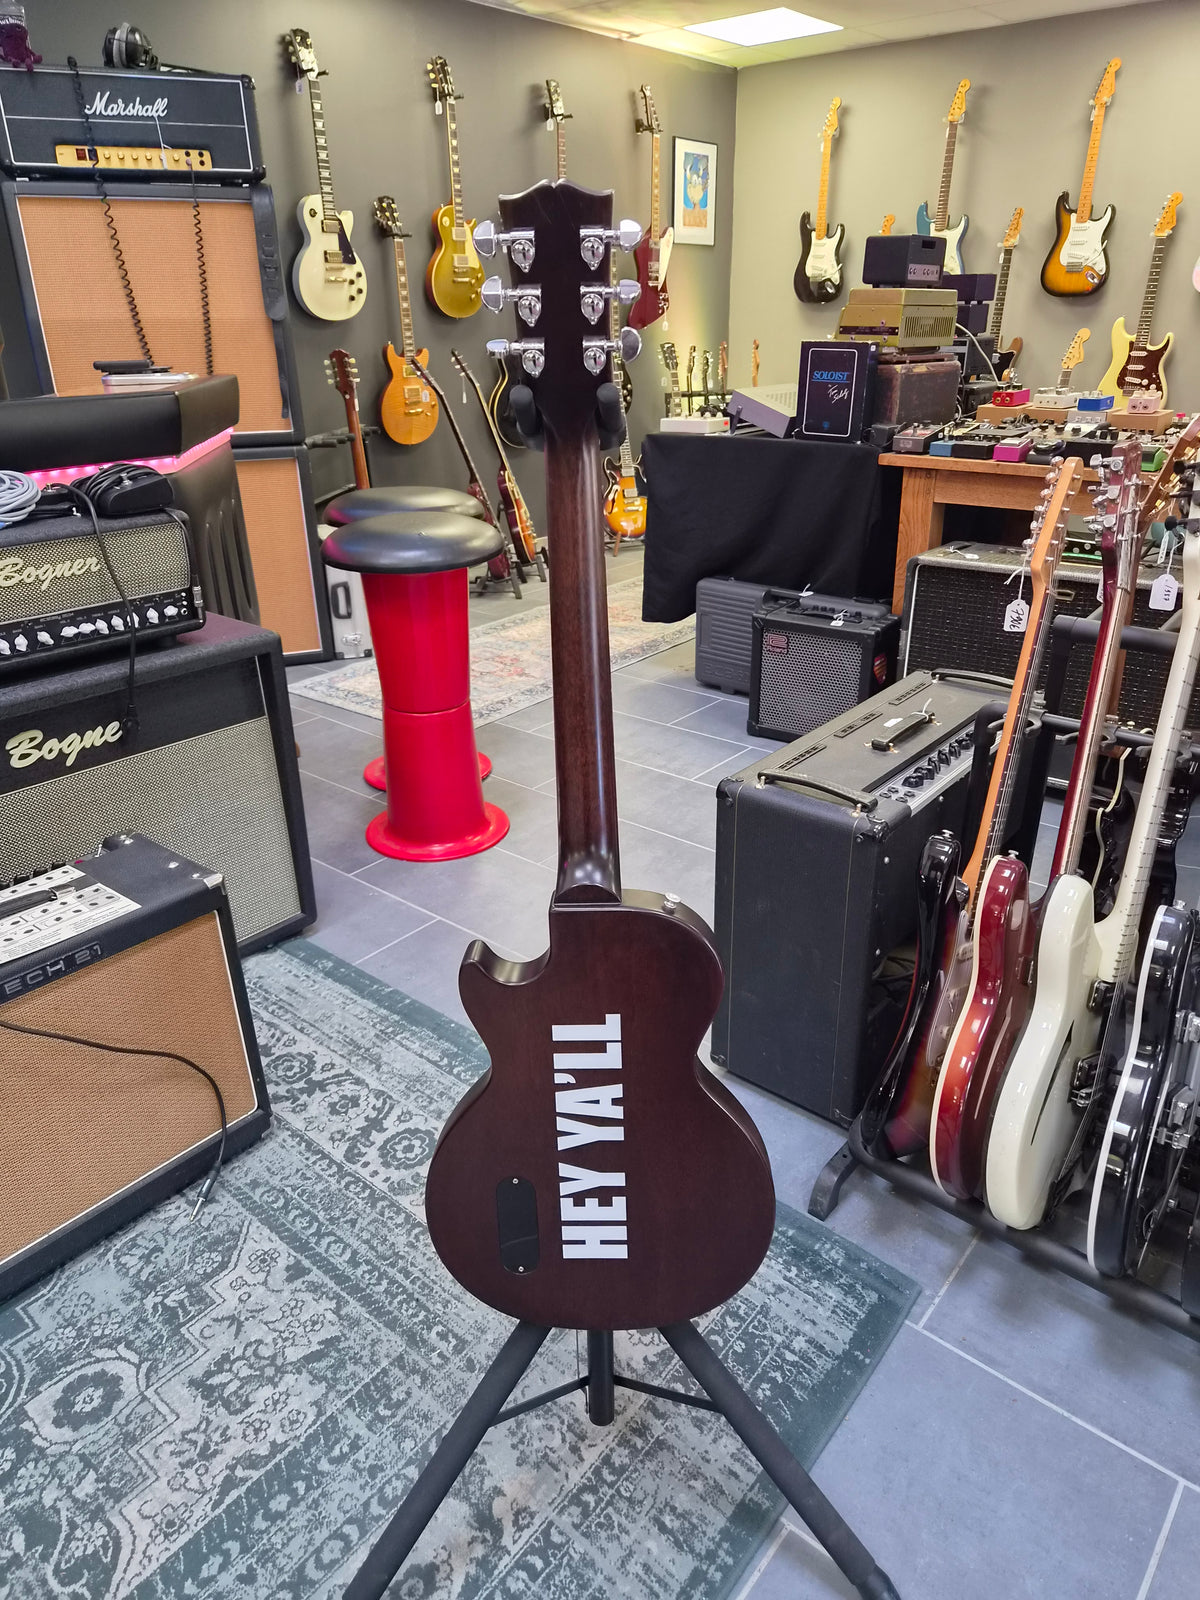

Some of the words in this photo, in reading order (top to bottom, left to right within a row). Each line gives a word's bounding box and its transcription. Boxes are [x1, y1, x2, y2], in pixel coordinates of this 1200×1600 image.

[84, 91, 168, 117] Marshall
[812, 370, 850, 380] SOLOIST
[0, 556, 101, 591] Bogner
[4, 960, 65, 995] ECH
[75, 944, 102, 965] 21
[551, 1013, 625, 1151] YA'LL
[558, 1162, 628, 1260] HEY
